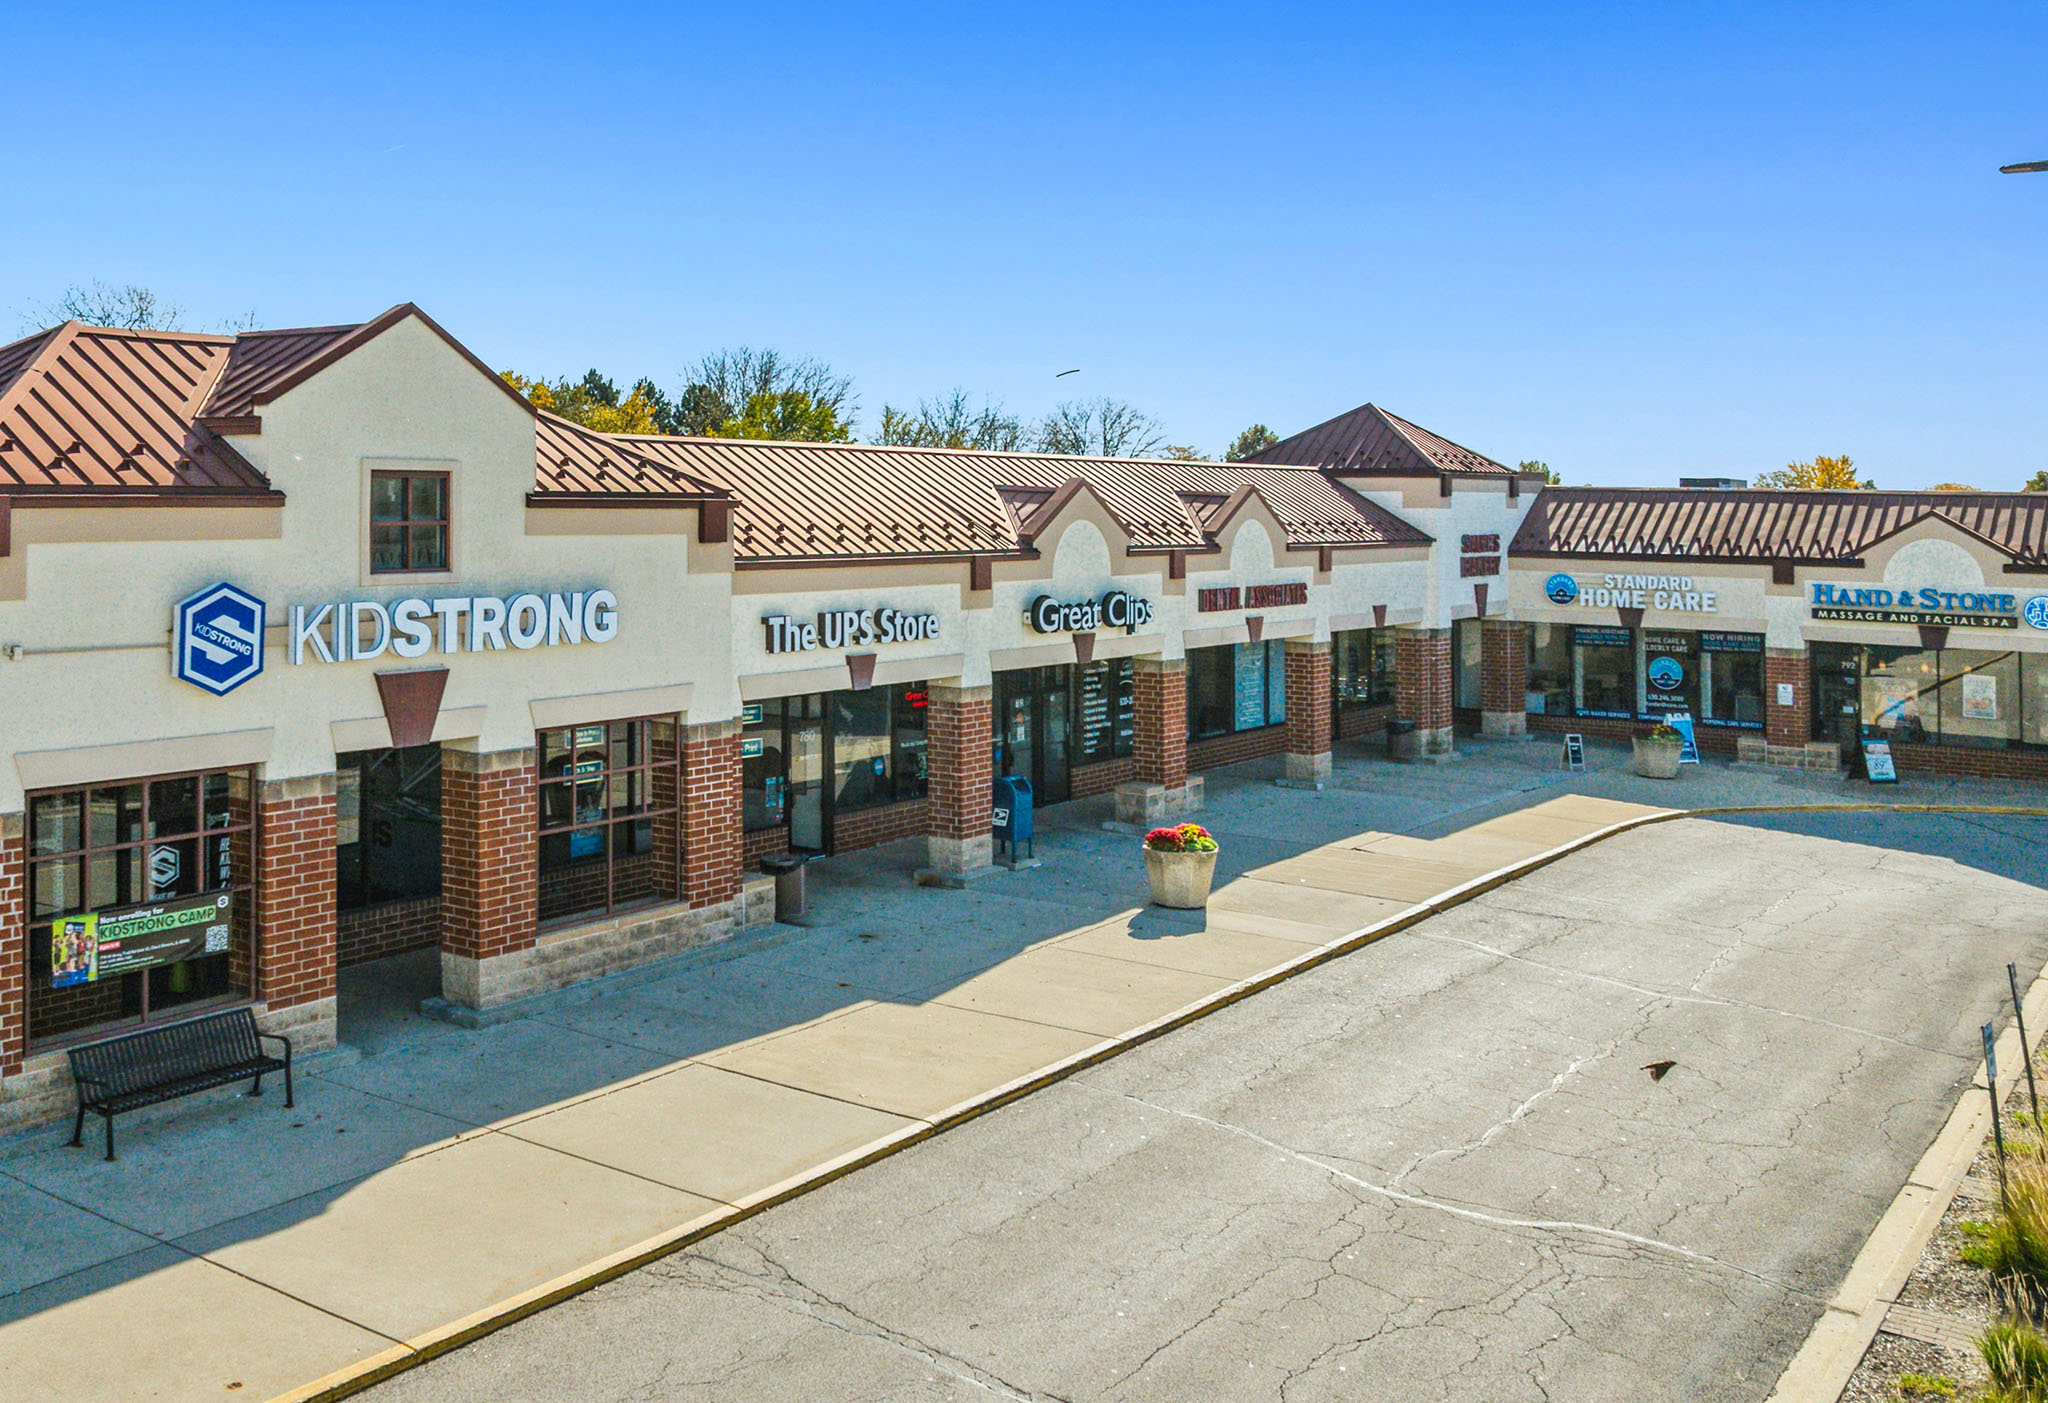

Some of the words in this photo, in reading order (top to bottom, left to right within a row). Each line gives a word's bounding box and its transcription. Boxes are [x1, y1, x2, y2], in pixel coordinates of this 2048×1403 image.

[1605, 574, 1692, 591] STANDARD
[1199, 588, 1243, 612] DENTAL
[1245, 583, 1308, 608] ASSOCIATES
[1580, 588, 1648, 609] HOME
[1654, 591, 1718, 612] CARE
[1812, 583, 1893, 607] HAND
[1897, 590, 1914, 607] &
[1919, 587, 2016, 612] STONE
[290, 589, 618, 666] KIDSTRONG
[1036, 597, 1103, 632] Great
[1106, 593, 1154, 633] Clips
[1817, 610, 1884, 622] MASSAGE
[1890, 613, 1918, 622] AND
[1925, 615, 1977, 625] FACIAL
[1983, 618, 2009, 627] SPA
[194, 622, 252, 655] KIDSTRONG
[765, 615, 816, 654] The
[822, 610, 874, 649] UPS
[878, 608, 940, 643] Store
[1702, 633, 1725, 641] NOW
[1727, 634, 1761, 642] HIRING
[799, 730, 816, 742] 780
[100, 916, 117, 924] Now
[118, 909, 151, 922] enrolling
[152, 907, 164, 915] for
[100, 912, 175, 939] KIDSTRONG
[178, 907, 215, 926] CAMP
